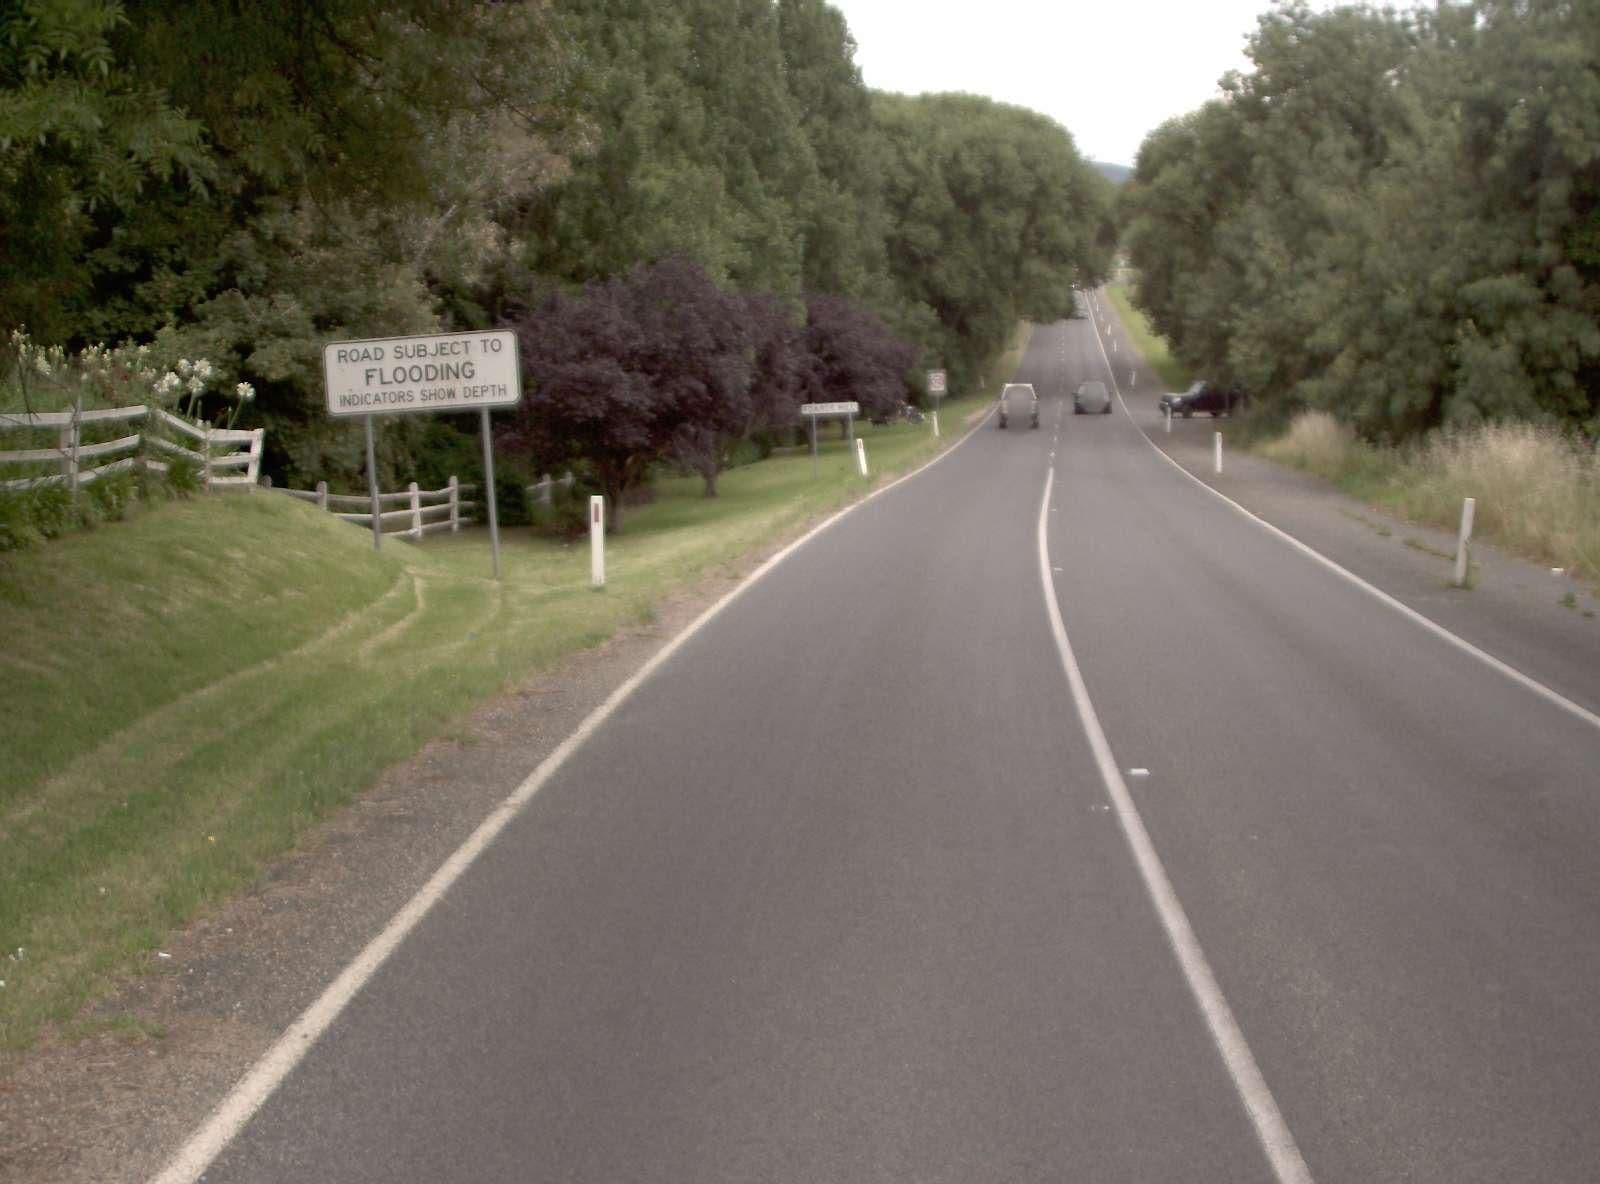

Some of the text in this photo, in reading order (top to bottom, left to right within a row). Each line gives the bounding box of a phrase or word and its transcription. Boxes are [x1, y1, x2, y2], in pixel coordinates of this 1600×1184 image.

[337, 338, 502, 363] ROAD SUBJECT TO
[365, 361, 475, 386] FLOODING
[339, 384, 507, 407] INDICATORS SHOW DEPTH
